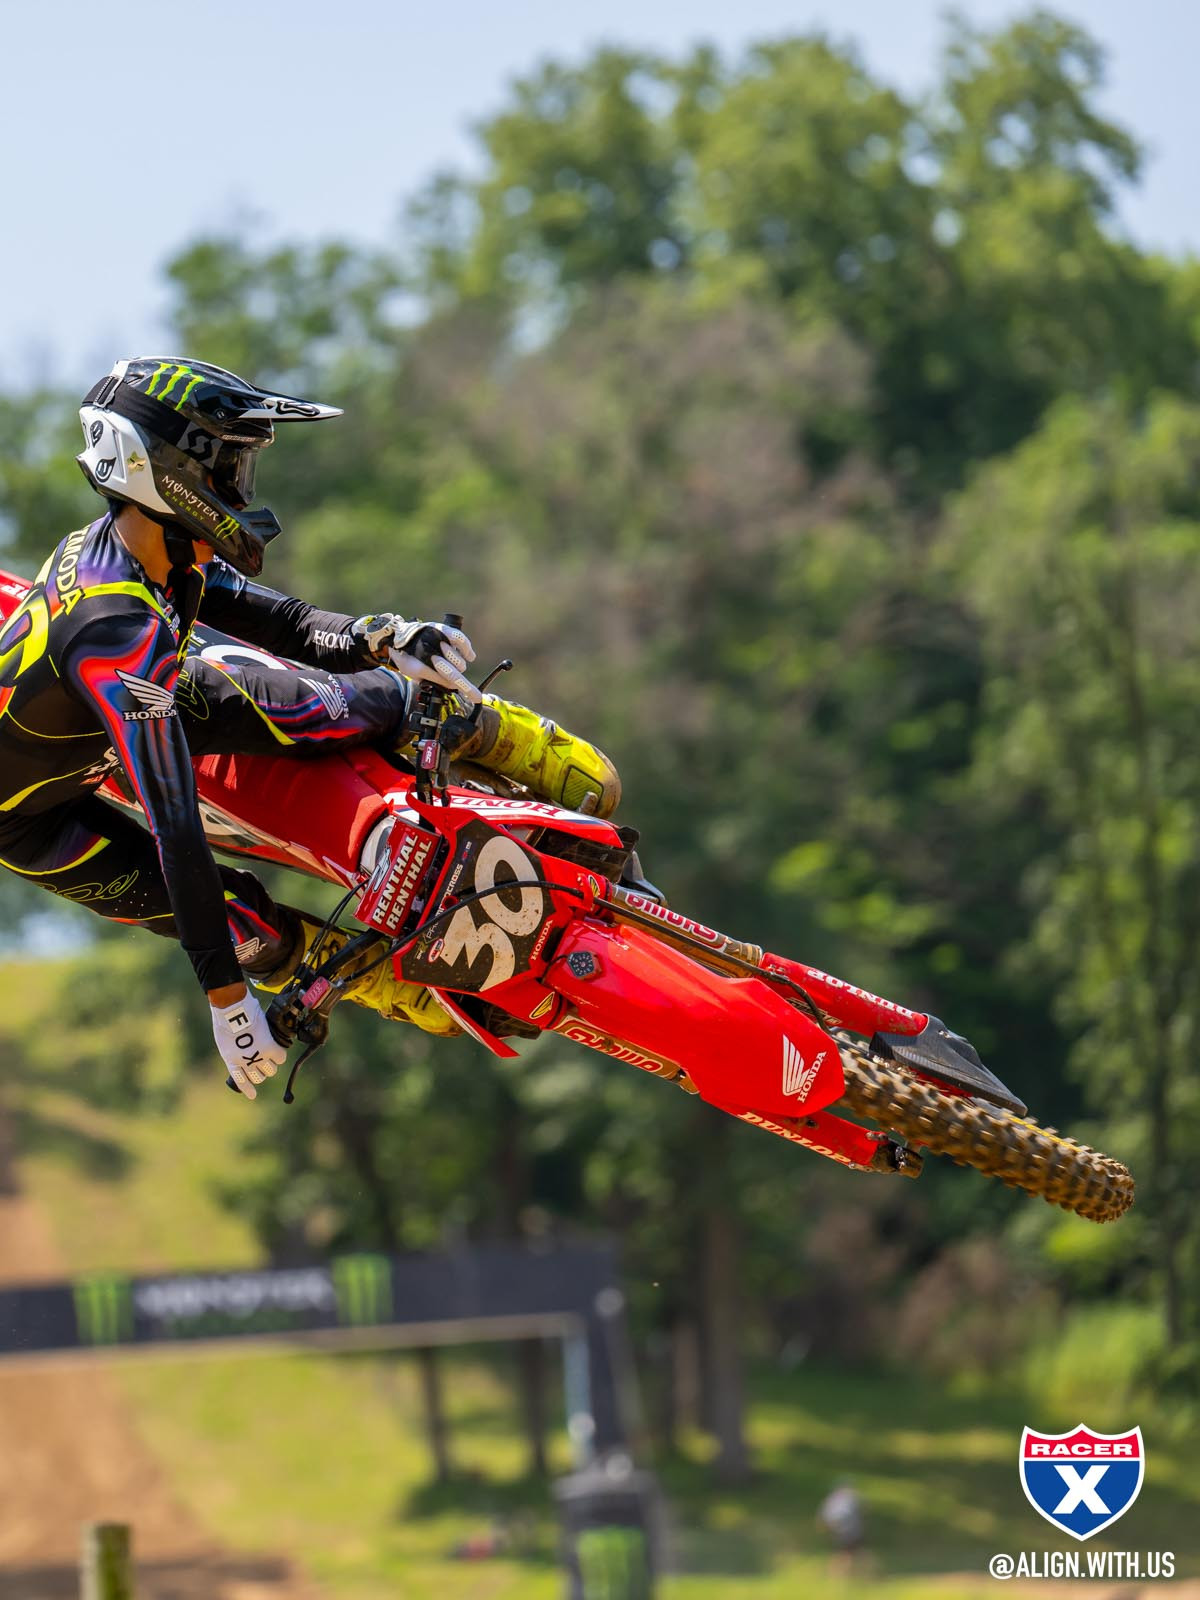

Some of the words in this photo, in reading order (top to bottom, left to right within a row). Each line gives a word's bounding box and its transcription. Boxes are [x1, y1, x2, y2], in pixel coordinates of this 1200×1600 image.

[161, 474, 220, 521] MONSTER
[164, 490, 204, 521] ENERGY
[123, 709, 178, 721] HONDA
[327, 673, 350, 720] HONDA
[450, 795, 565, 817] HOND
[372, 835, 419, 925] RENTHAL
[385, 840, 432, 931] RENTHAL
[439, 835, 544, 993] 30
[530, 919, 554, 961] HONDA
[807, 968, 914, 1019] DUNLOP
[228, 1011, 264, 1067] FOX
[796, 1050, 828, 1104] HONDA
[737, 1111, 852, 1163] DUNLOP
